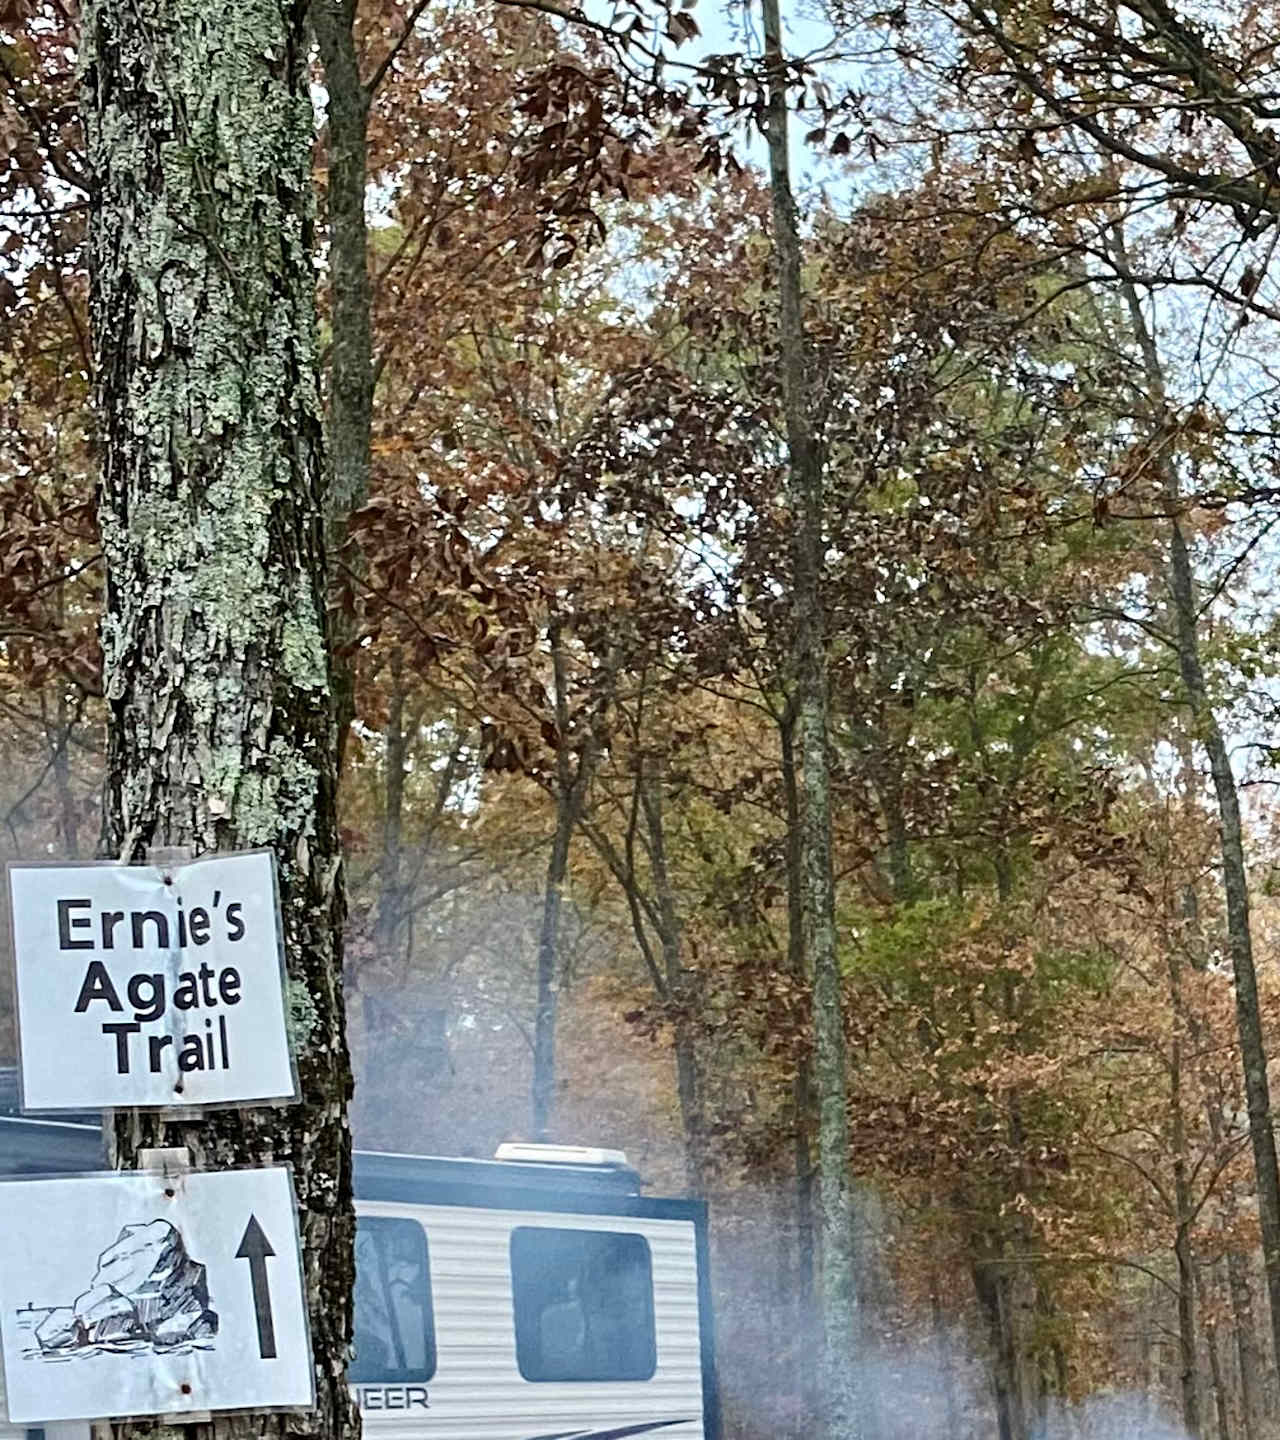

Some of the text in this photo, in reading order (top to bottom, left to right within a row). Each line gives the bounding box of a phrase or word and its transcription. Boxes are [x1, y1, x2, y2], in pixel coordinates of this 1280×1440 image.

[56, 890, 246, 950] Ernie's
[73, 960, 242, 1022] Agate
[101, 1014, 230, 1074] Trail
